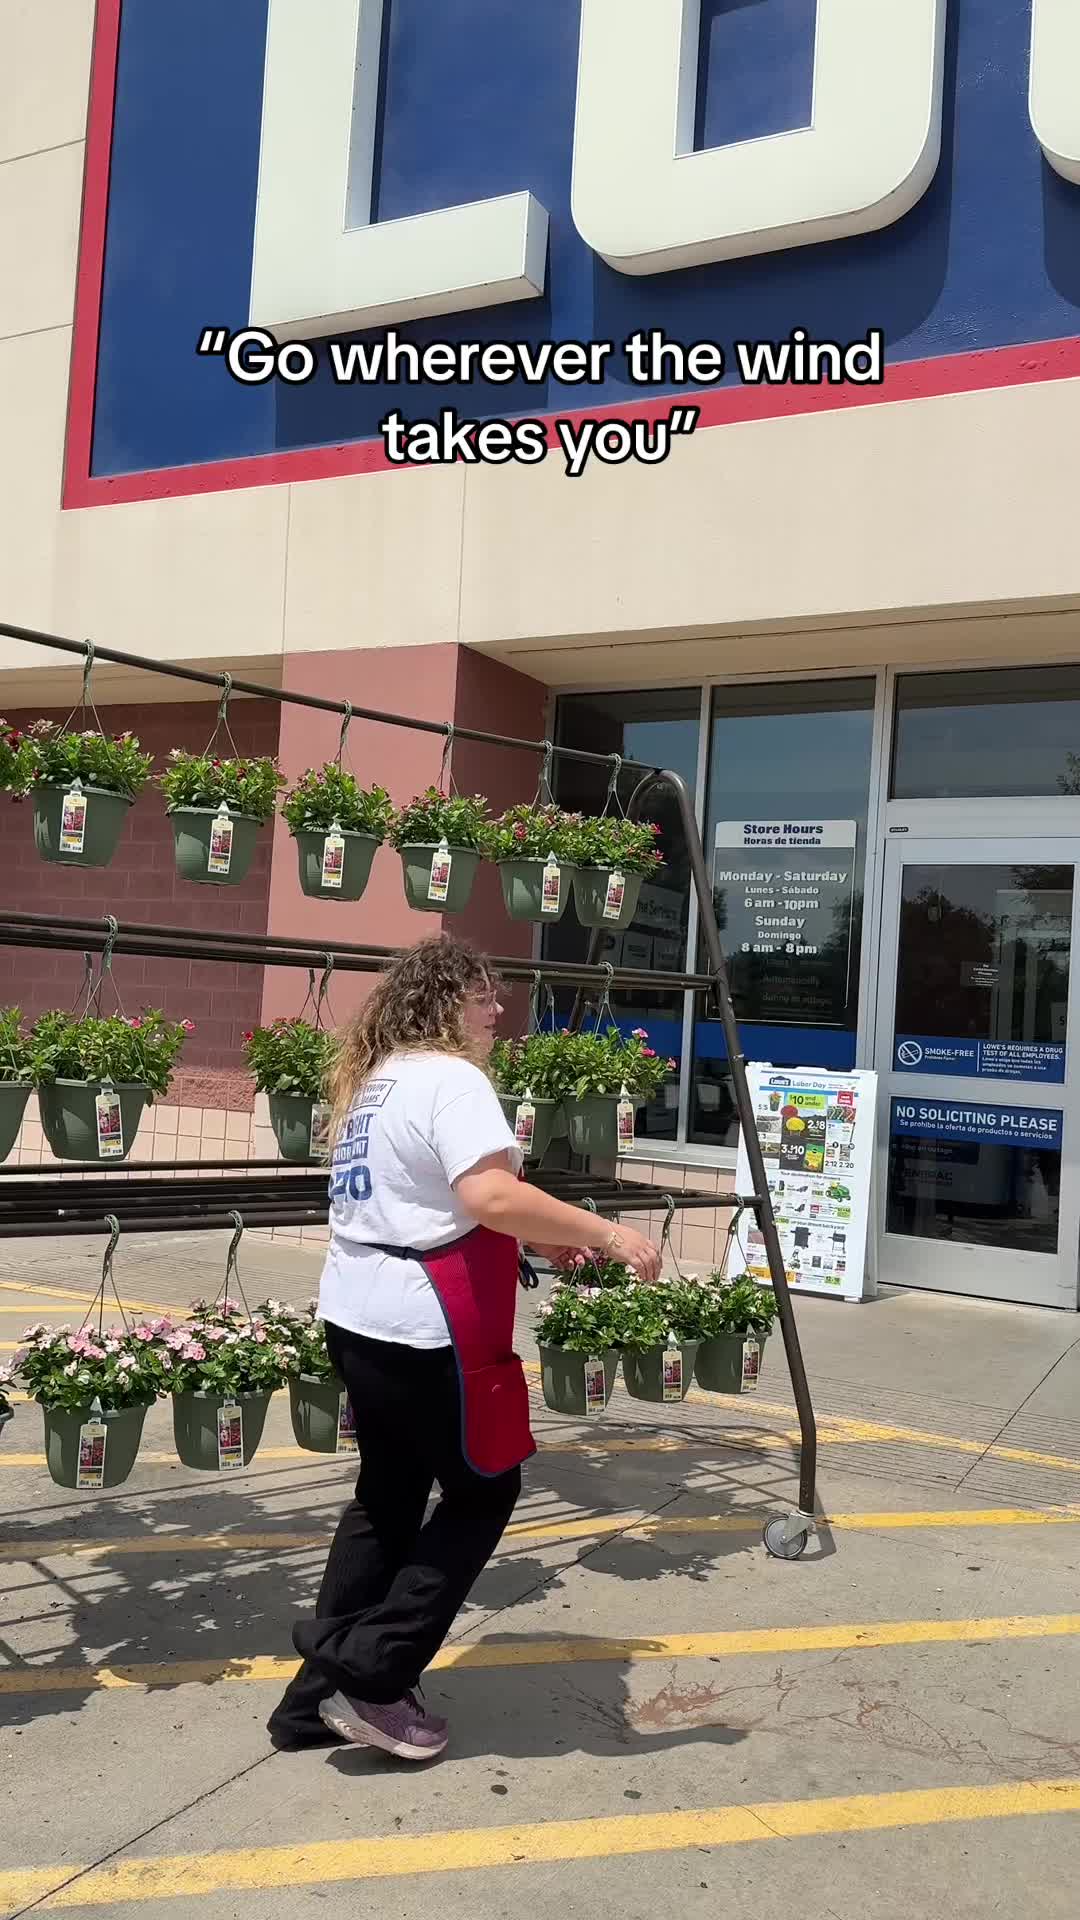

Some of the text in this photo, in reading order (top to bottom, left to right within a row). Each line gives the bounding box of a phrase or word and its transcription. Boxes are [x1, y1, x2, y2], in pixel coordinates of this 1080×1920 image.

[250, 0, 1080, 341] LO
[743, 824, 824, 835] Store Hours
[743, 837, 821, 845] Horas de tienda
[719, 871, 773, 883] Monday
[783, 871, 847, 883] Saturday
[745, 886, 773, 894] Lunes
[782, 885, 819, 894] Sábado
[744, 898, 753, 908] 6
[754, 900, 774, 908] am
[754, 915, 805, 929] Sunday
[757, 931, 802, 941] Domingo
[741, 942, 750, 952] 8
[752, 944, 774, 952] am
[924, 1047, 975, 1057] SMOKE-FREE
[982, 1043, 1006, 1051] LOWE'S
[1007, 1044, 1038, 1052] REQUIRES
[1022, 1052, 1061, 1060] EMPLOYEES.
[896, 1105, 1058, 1131] NO SOLICITING PLEASE
[909, 1120, 936, 1129] prohibe
[945, 1123, 966, 1132] oferta
[967, 1125, 976, 1133] de
[977, 1126, 1013, 1137] productos
[1020, 1131, 1053, 1139] servicios
